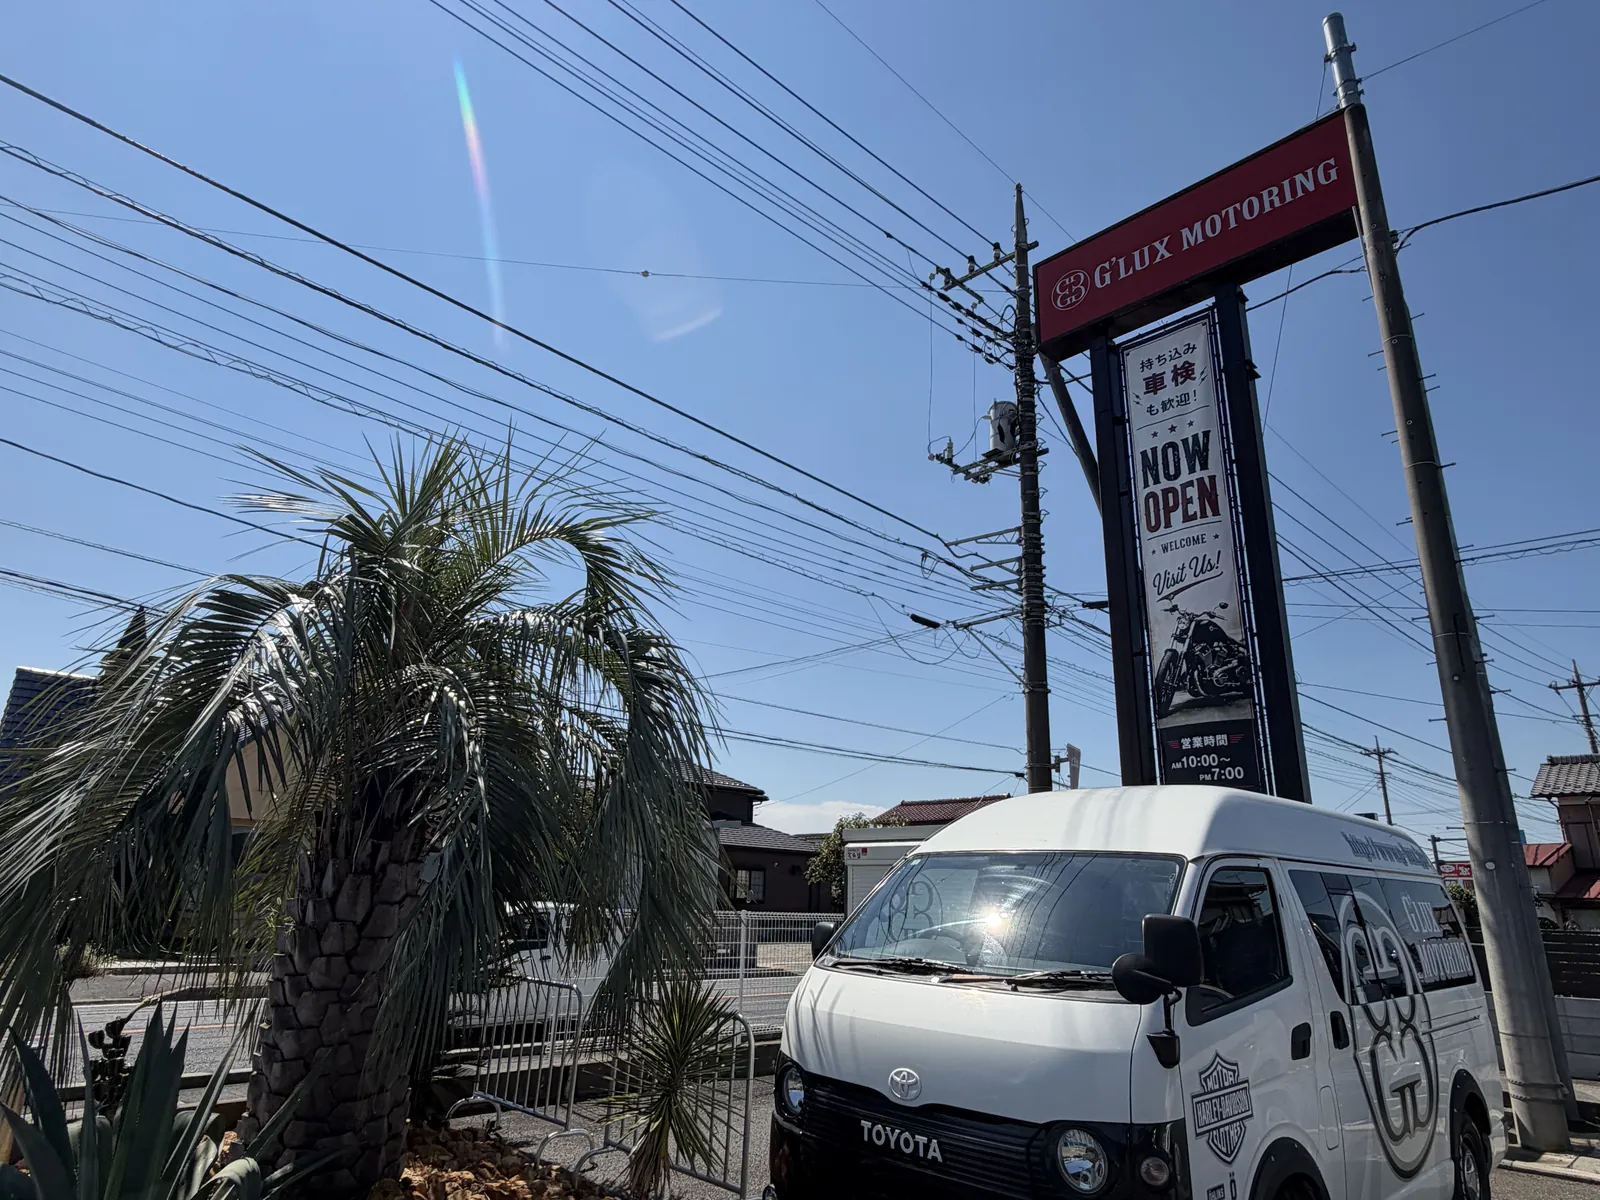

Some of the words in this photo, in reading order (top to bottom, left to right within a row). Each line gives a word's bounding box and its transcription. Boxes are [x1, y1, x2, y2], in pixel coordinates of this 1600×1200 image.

[1180, 157, 1339, 251] MOTORING
[1140, 342, 1197, 373] 持ち込み
[1143, 360, 1197, 396] 車検
[1140, 430, 1212, 489] NOW
[1144, 475, 1221, 533] OPEN
[1160, 533, 1207, 554] WELCOME
[1152, 563, 1187, 596] Visit
[1188, 550, 1222, 575] Us!
[1180, 733, 1229, 750] 営業時間
[1417, 941, 1473, 980] MOTORING
[1197, 1088, 1249, 1127] HARLEY-DAVIDSON
[860, 1119, 943, 1163] TOYOTA
